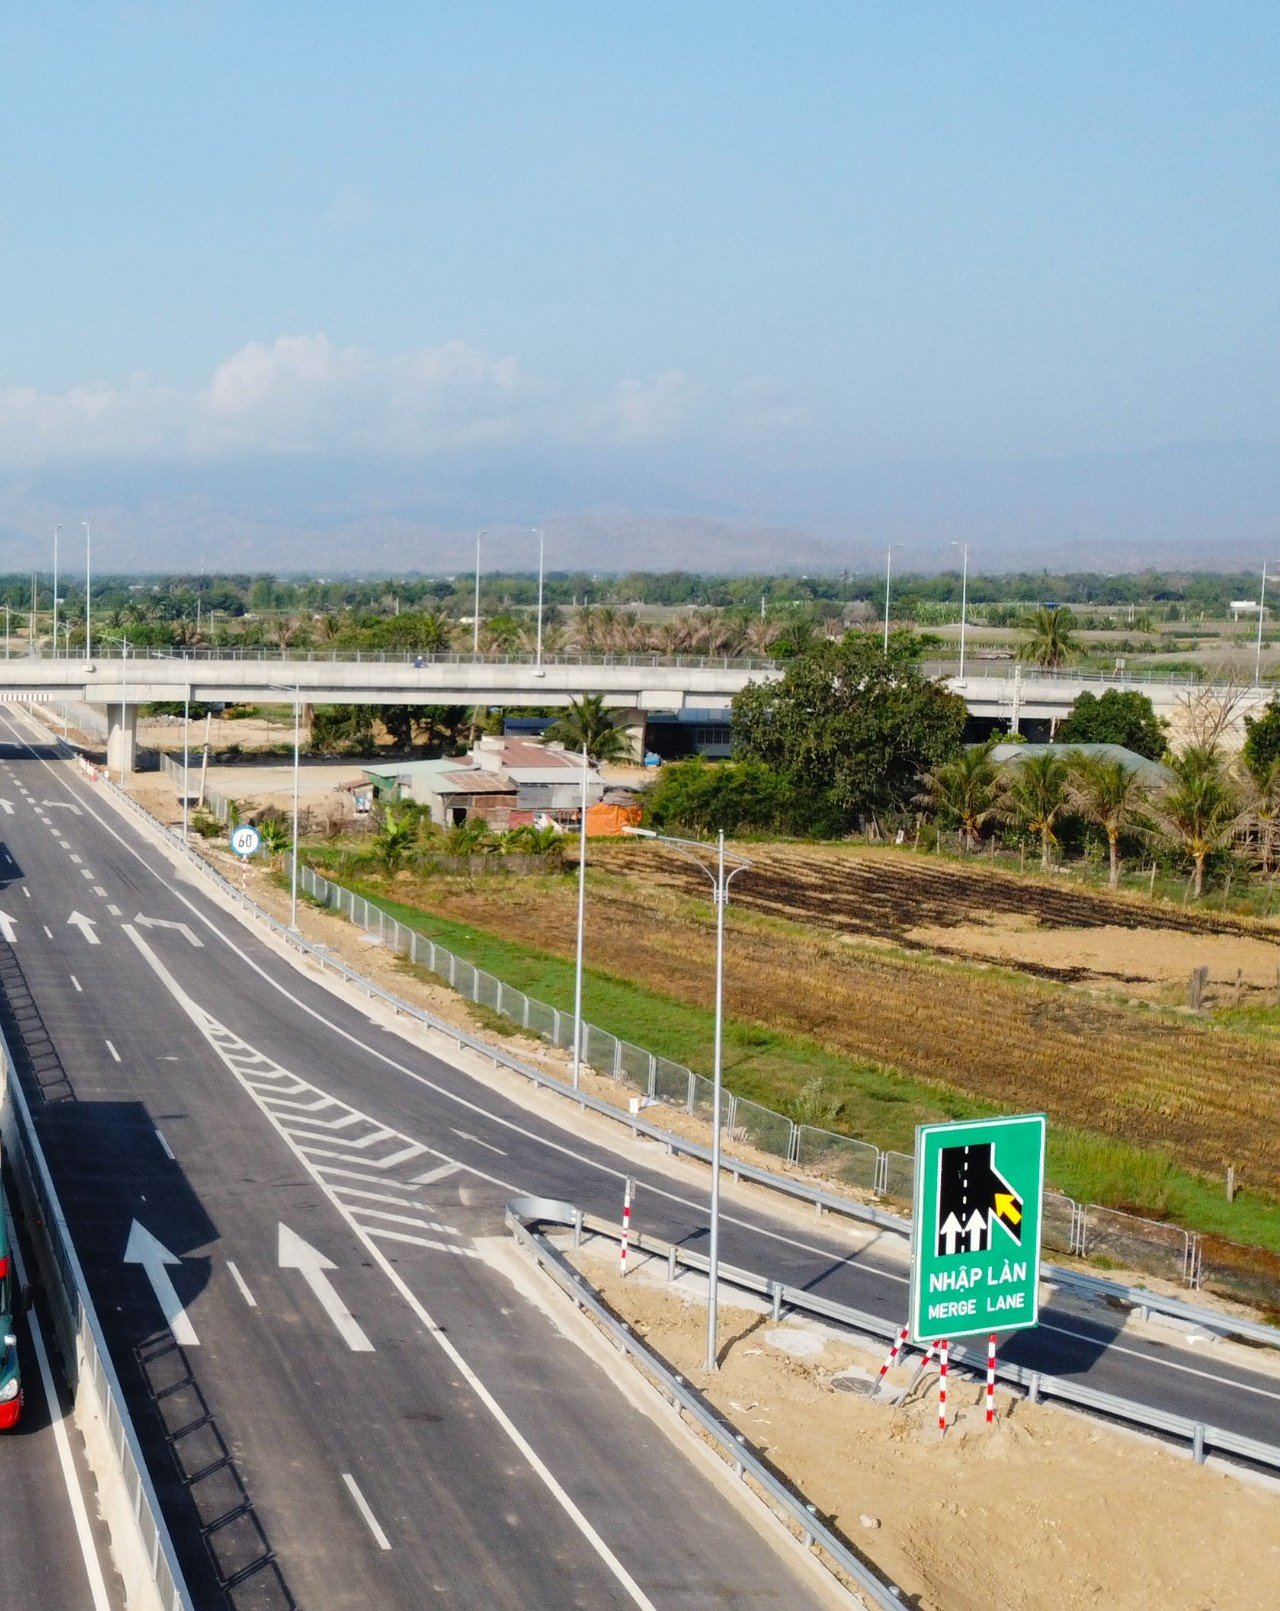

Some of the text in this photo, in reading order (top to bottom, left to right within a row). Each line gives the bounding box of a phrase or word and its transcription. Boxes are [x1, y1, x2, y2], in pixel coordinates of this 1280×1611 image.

[238, 834, 253, 848] 60
[929, 1258, 1028, 1294] NHẬP LÀN
[928, 1292, 1026, 1320] MERGE LANE
